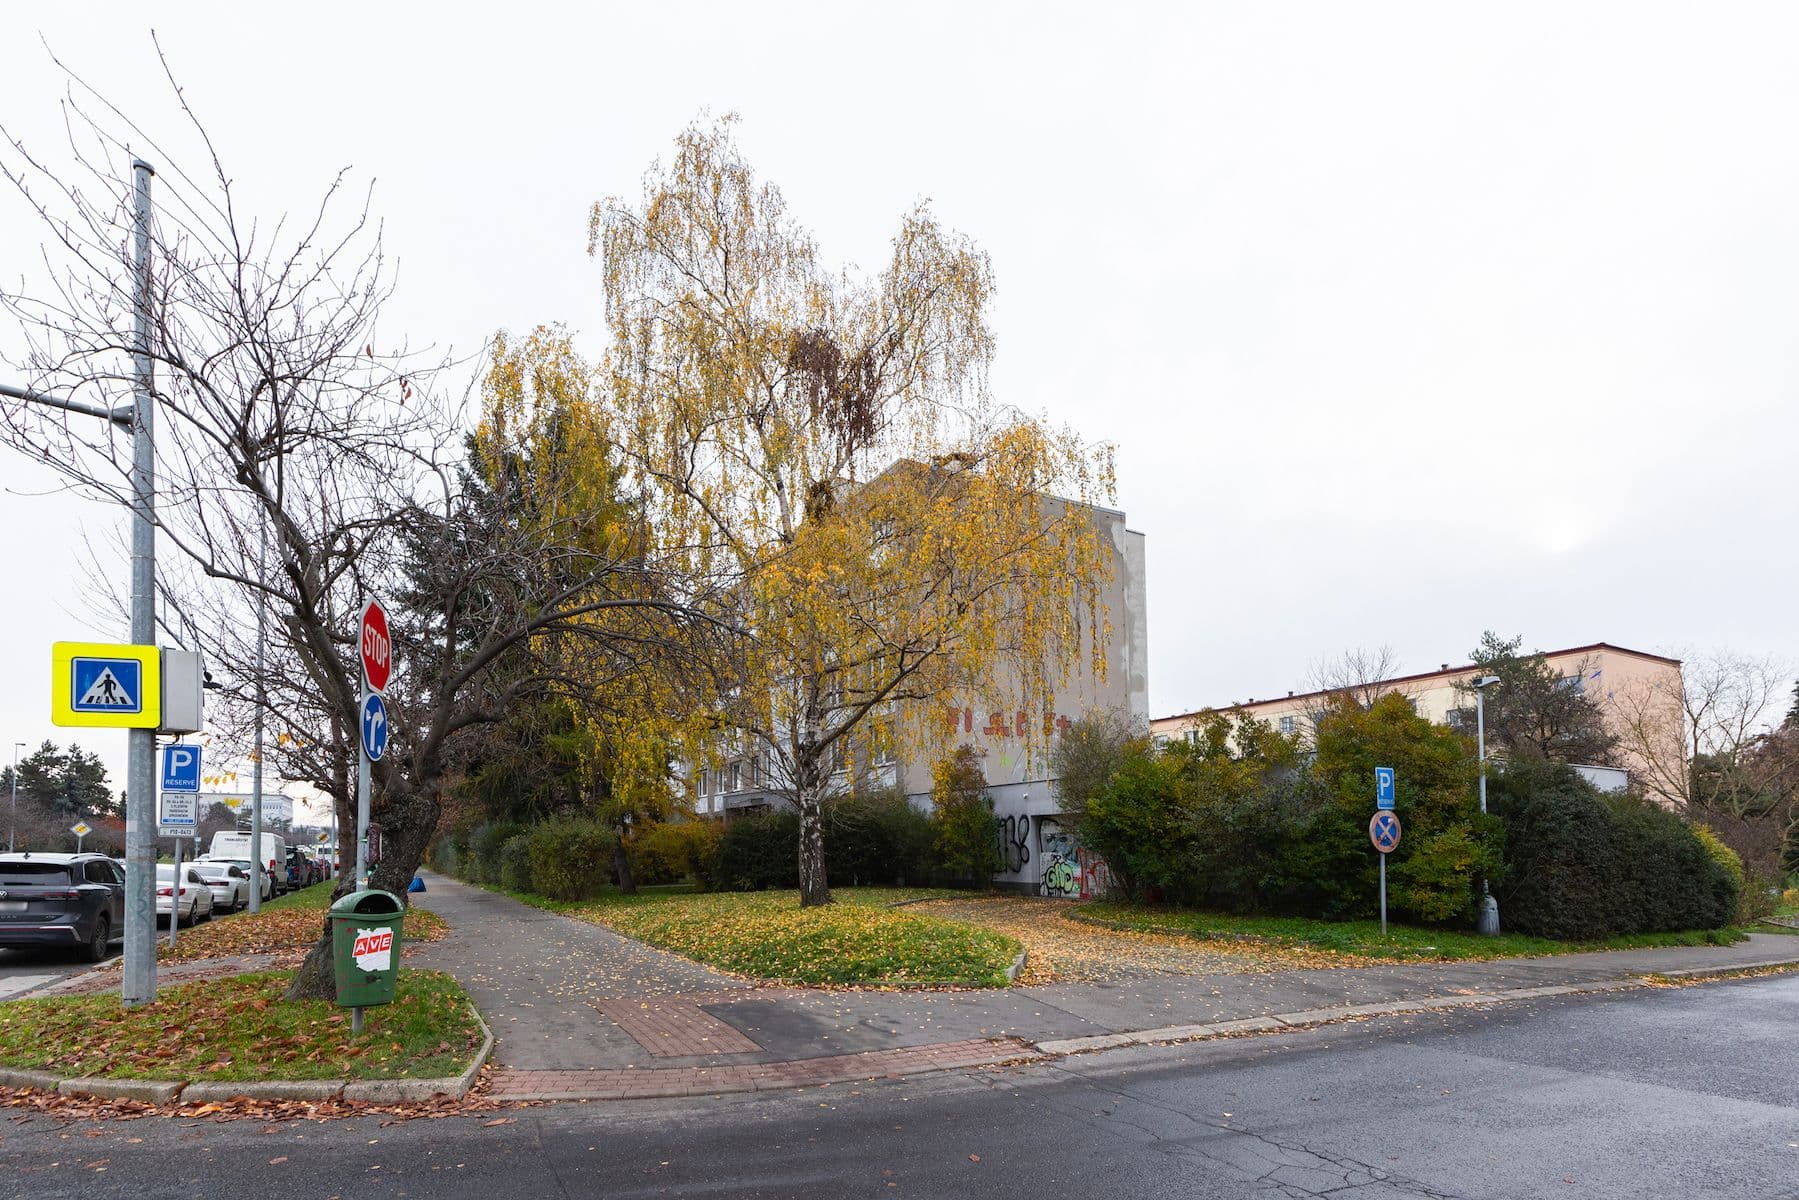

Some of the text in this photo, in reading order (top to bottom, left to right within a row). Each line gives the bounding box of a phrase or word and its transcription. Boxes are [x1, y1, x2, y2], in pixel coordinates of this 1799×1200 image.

[365, 623, 388, 668] STOP
[171, 750, 192, 776] P
[1380, 772, 1390, 796] P
[355, 936, 391, 953] AVE
